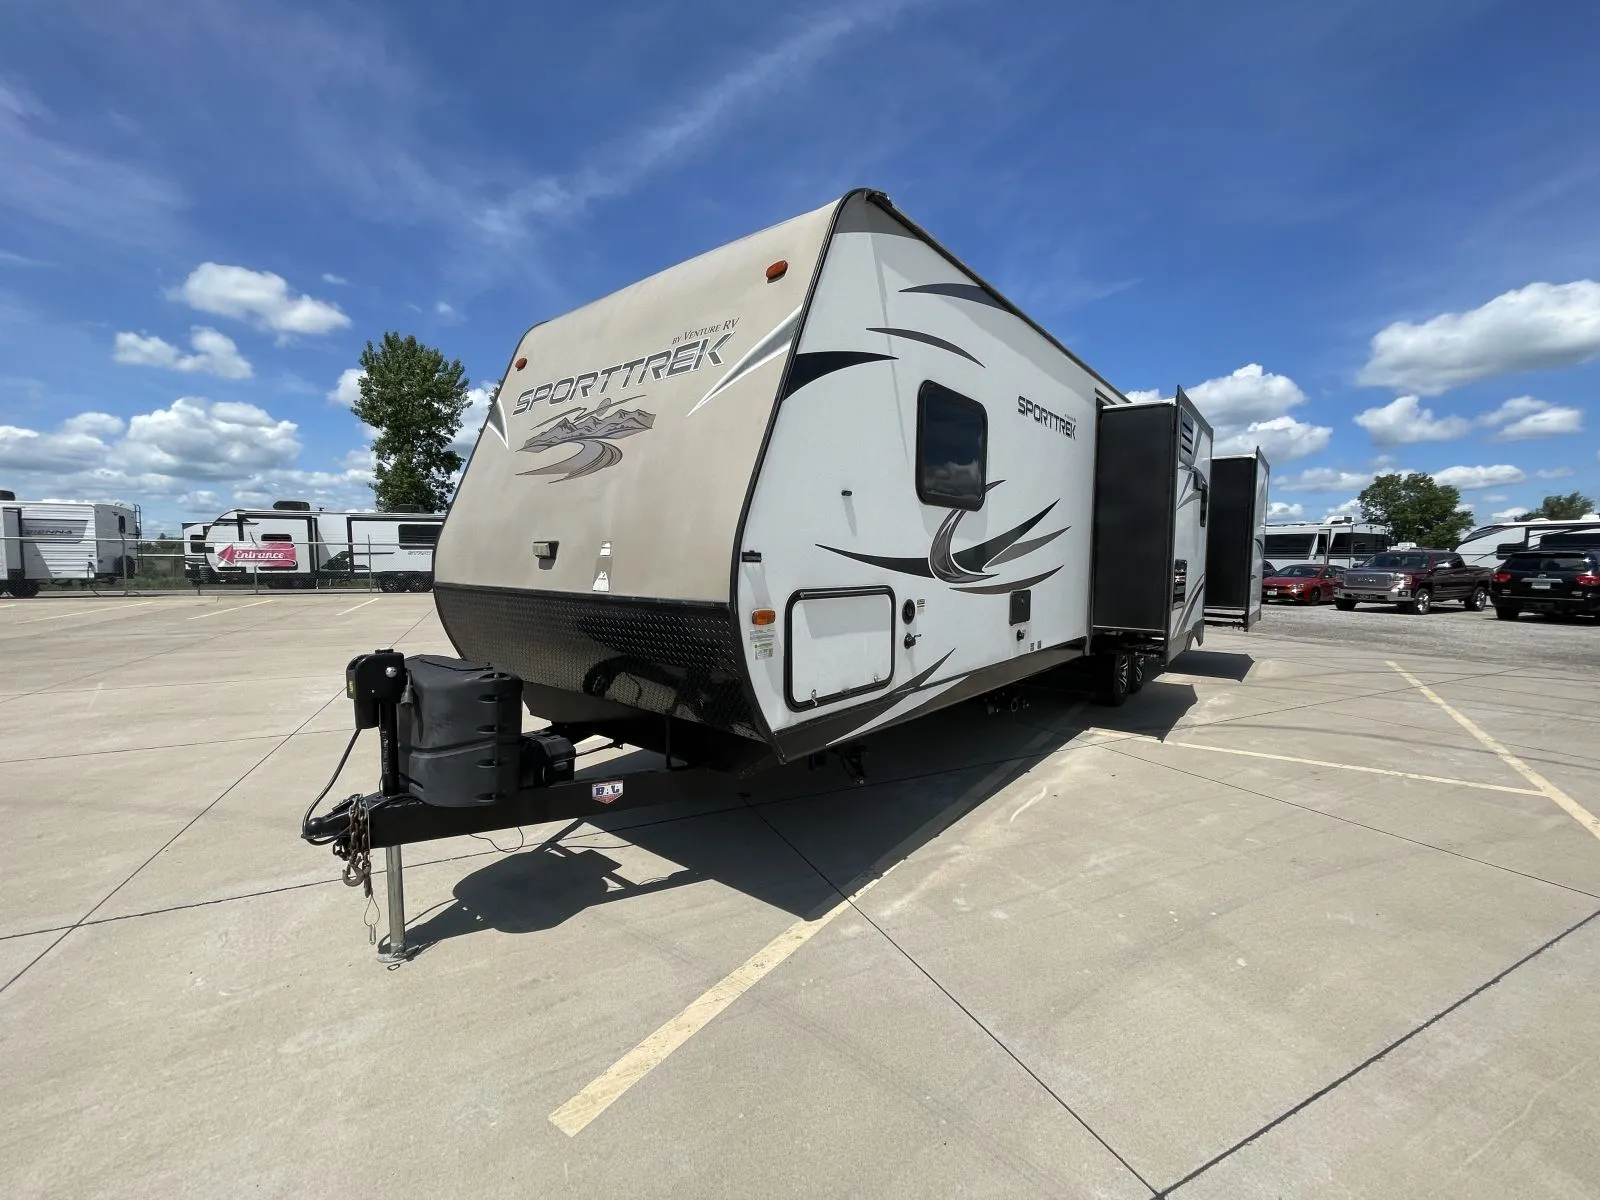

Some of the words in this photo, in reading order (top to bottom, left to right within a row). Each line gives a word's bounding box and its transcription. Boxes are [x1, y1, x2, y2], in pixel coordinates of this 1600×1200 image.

[672, 336, 682, 345] BY
[684, 325, 721, 340] VENTURE
[723, 317, 740, 330] RV
[512, 331, 736, 416] SPORTTREK
[1018, 395, 1076, 440] SPORTTREK
[234, 550, 285, 559] Entrance
